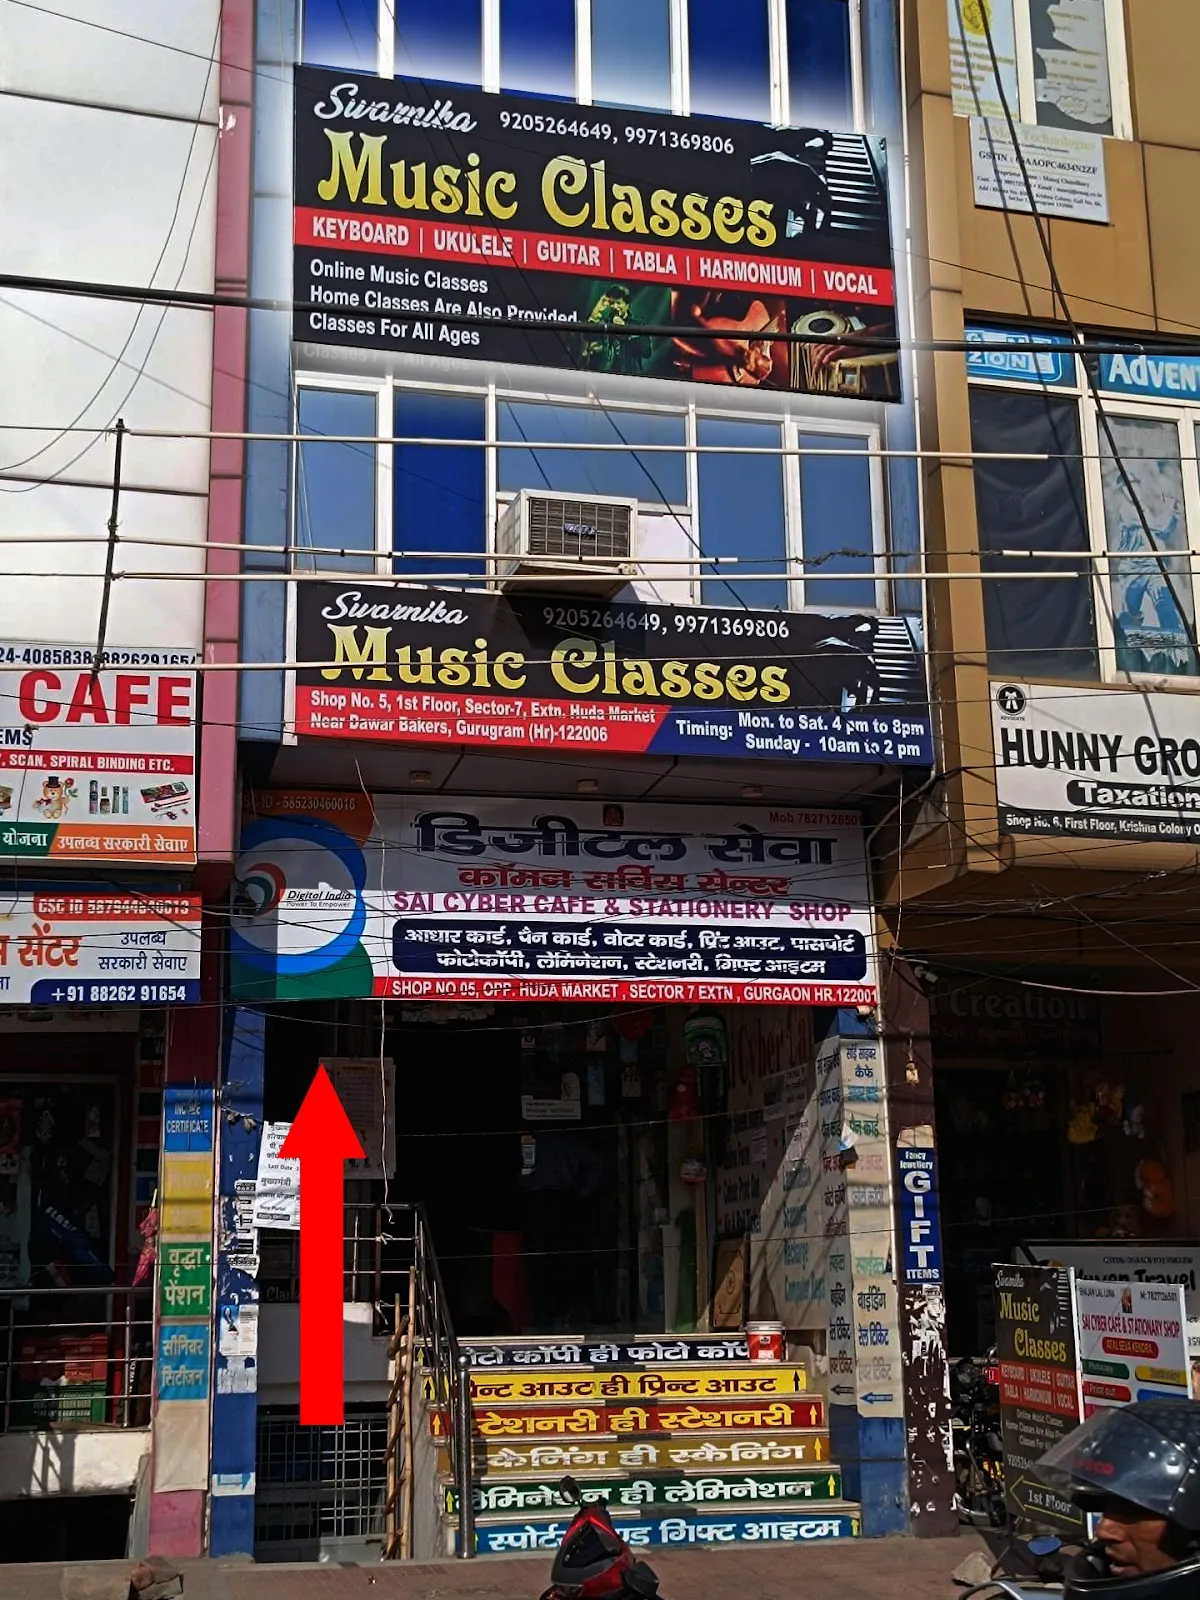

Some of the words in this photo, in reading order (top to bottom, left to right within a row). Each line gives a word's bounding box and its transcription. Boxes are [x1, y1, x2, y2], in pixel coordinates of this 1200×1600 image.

[500, 111, 619, 144] 9205264649,
[624, 124, 734, 154] 9971369806
[317, 127, 518, 219] Music
[542, 156, 777, 248] Classes
[312, 216, 409, 246] KEYBOARD
[433, 229, 513, 258] UKULELE
[536, 241, 600, 267] GUITAR
[622, 250, 678, 274] TABLA
[698, 257, 802, 287] HARMONIUM
[823, 270, 878, 295] VOCAL
[310, 258, 365, 280] Online
[370, 265, 419, 287] Music
[424, 270, 488, 294] Classes
[310, 285, 359, 305] Home
[364, 290, 429, 312] Classes
[434, 298, 462, 315] Are
[309, 312, 376, 336] Classes
[380, 319, 408, 339] For
[412, 322, 434, 341] All
[438, 326, 480, 346] Ages
[543, 606, 668, 635] 9205264649,
[674, 615, 790, 639] 9971369806
[321, 623, 528, 691] Music
[552, 637, 792, 703] Classes
[19, 671, 192, 726] CAFE
[311, 690, 346, 710] Shop
[351, 691, 374, 709] No.
[379, 693, 391, 712] 5,
[397, 694, 418, 711] 1st
[422, 696, 461, 715] Floor,
[465, 698, 527, 719] Sector-7,
[531, 702, 566, 718] Extn.
[570, 704, 605, 720] Huda
[608, 705, 656, 723] Market
[311, 712, 345, 729] Near
[350, 714, 395, 731] Dawar
[399, 716, 452, 738] Bakers,
[456, 719, 525, 741] Gurugram
[529, 723, 609, 743] (Hr)-122006
[676, 719, 733, 741] Timing:
[738, 712, 775, 729] Mon.
[778, 715, 794, 729] to
[799, 715, 829, 730] Sat.
[832, 716, 842, 731] 4
[846, 718, 869, 735] pm
[872, 719, 888, 733] to
[892, 719, 925, 737] 8pm
[745, 734, 801, 754] Sunday
[819, 736, 860, 753] 10am
[884, 740, 894, 755] 2
[897, 742, 921, 759] pm
[1000, 727, 1123, 773] HUNNY
[50, 755, 94, 769] SPIRAL
[97, 757, 146, 771] BINDING
[149, 759, 175, 772] ETC.
[769, 811, 794, 824] Mob
[1006, 814, 1032, 829] Shop
[1065, 818, 1088, 830] First
[1090, 819, 1117, 833] Floor,
[1119, 820, 1157, 834] Krishna
[3, 828, 48, 847] योजना
[704, 822, 838, 865] सेवा
[287, 890, 323, 902] Digital
[325, 891, 352, 901] India
[394, 892, 434, 913] SAI
[443, 893, 526, 913] CYBER
[534, 895, 596, 915] CAFE
[604, 897, 619, 915] &
[629, 898, 774, 921] STATIONERY
[789, 902, 851, 922] SHOP
[404, 929, 463, 944] आधार
[465, 926, 512, 946] कार्ड,
[518, 927, 547, 945] पैन
[552, 927, 598, 947] कार्ड,
[603, 929, 645, 947] वोटर
[649, 929, 693, 949] कार्ड,
[98, 950, 148, 970] सरकारी
[52, 986, 84, 1001] +91
[90, 986, 135, 1001] 88262
[140, 986, 186, 1001] 91654
[392, 980, 431, 996] SHOP
[435, 981, 457, 996] NO
[460, 982, 479, 998] 05,
[519, 982, 559, 998] HUDA
[561, 982, 619, 999] MARKET
[629, 984, 685, 1000] SECTOR
[687, 985, 695, 999] 7
[699, 985, 733, 1000] EXTN
[744, 988, 811, 1002] GURGAON
[949, 988, 1087, 1020] Creation
[166, 1120, 209, 1133] CERTIFICATE
[905, 1151, 926, 1160] Fancy
[904, 1170, 935, 1267] GIFT
[906, 1269, 939, 1279] ITEMS
[164, 1279, 206, 1305] पेंशन
[1000, 1292, 1040, 1322] Music
[513, 1344, 583, 1364] कॉपी
[589, 1344, 620, 1363] ही
[627, 1342, 691, 1361] फोटो
[1014, 1327, 1066, 1363] Classes
[519, 1380, 595, 1398] आउट
[600, 1374, 631, 1396] ही
[639, 1374, 701, 1396] प्रिन्ट
[704, 1378, 777, 1394] आउट
[608, 1406, 650, 1433] ही
[658, 1403, 794, 1430] स्टेशनरी
[618, 1444, 660, 1467] ही
[619, 1480, 656, 1505] ही
[664, 1478, 815, 1502] लेमिनेशन
[1028, 1488, 1046, 1504] 1st
[658, 1518, 737, 1544] गिफ्ट
[741, 1519, 842, 1541] आइटम
